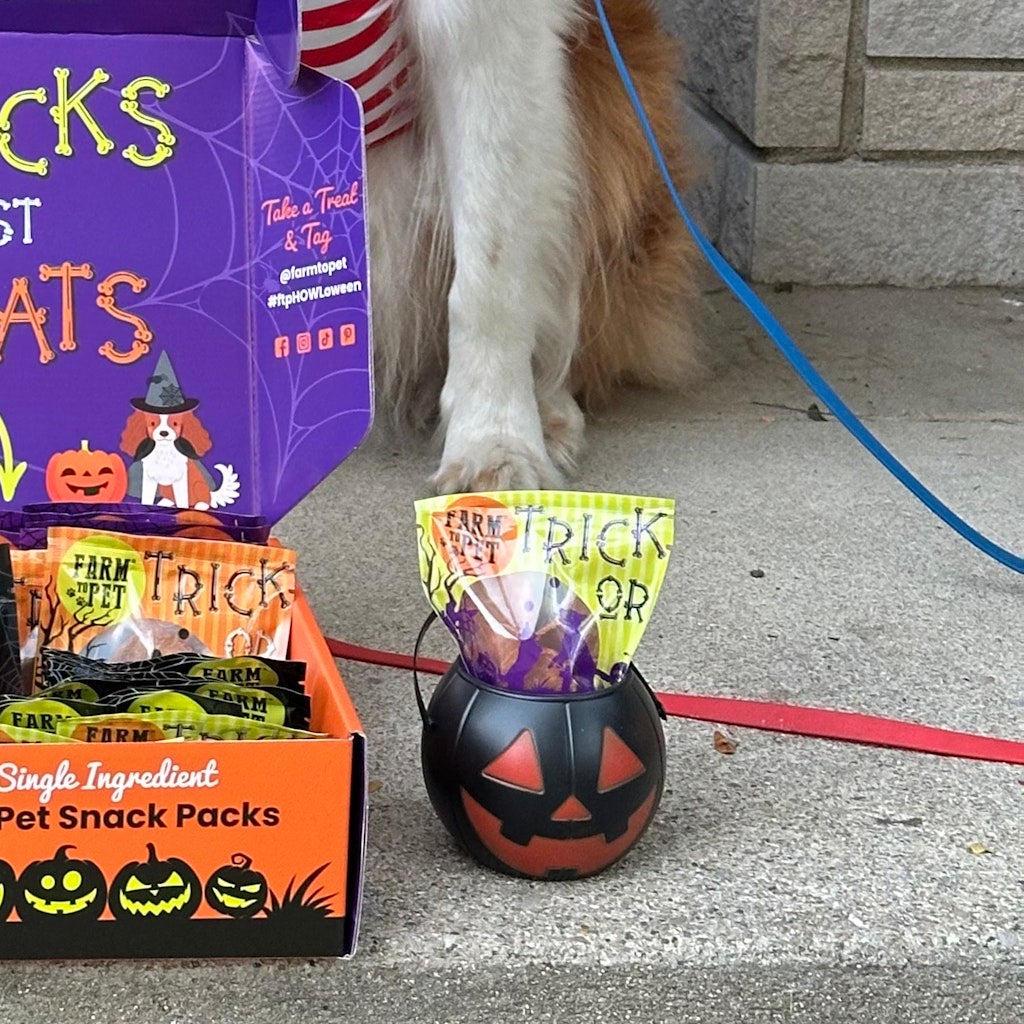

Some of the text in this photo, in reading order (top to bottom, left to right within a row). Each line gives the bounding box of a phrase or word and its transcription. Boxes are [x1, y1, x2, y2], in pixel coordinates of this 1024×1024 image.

[261, 181, 359, 226] Take a Treat
[284, 221, 333, 254] & Tag
[279, 256, 348, 285] @farmtopet
[267, 279, 362, 309] #ftpHOWLoween
[445, 509, 503, 537] FARM
[515, 504, 669, 567] TRICK
[73, 553, 131, 582] FARM
[77, 581, 126, 610] TO PET
[144, 550, 291, 617] TRICK
[596, 575, 650, 623] OR
[81, 758, 219, 803] Ingredient
[59, 804, 168, 829] Snack
[176, 802, 280, 828] Packs
